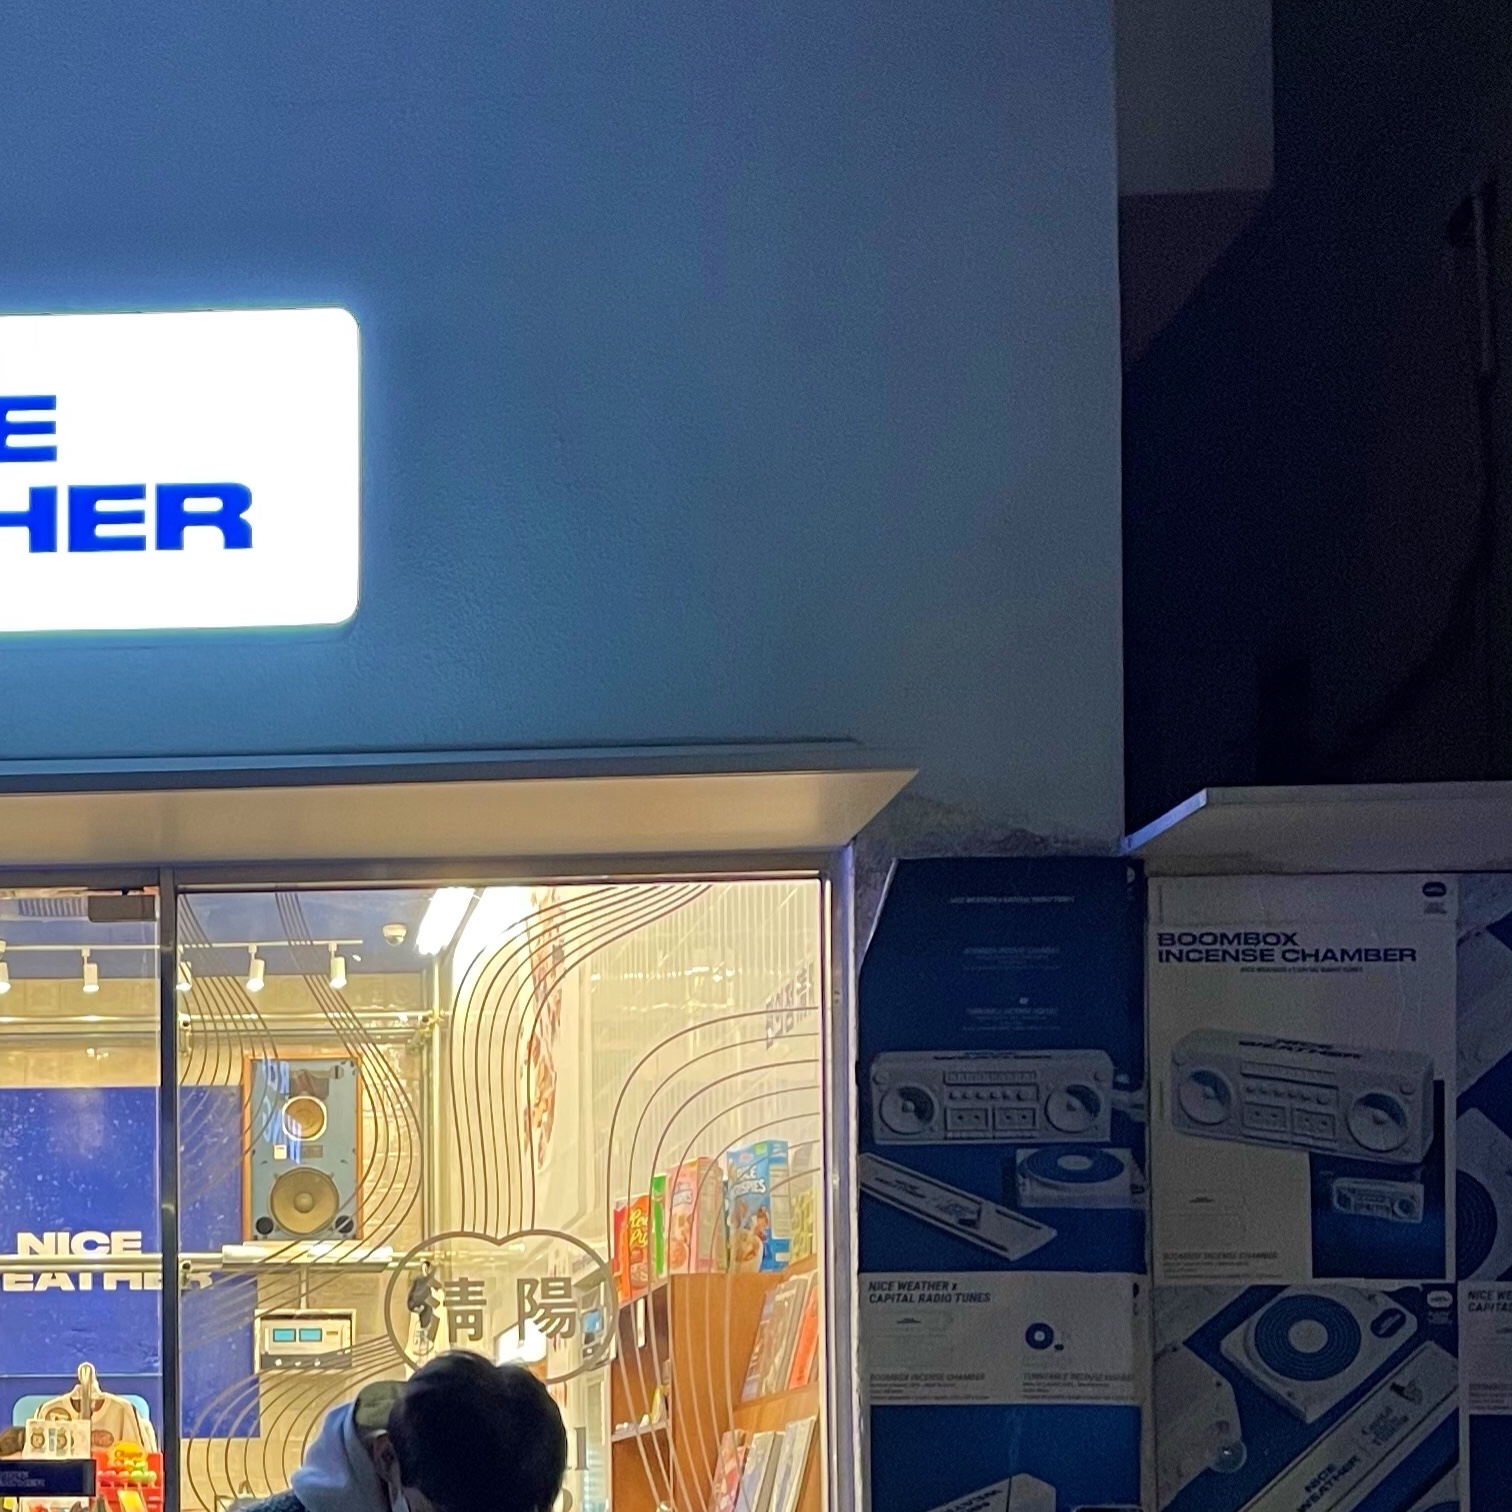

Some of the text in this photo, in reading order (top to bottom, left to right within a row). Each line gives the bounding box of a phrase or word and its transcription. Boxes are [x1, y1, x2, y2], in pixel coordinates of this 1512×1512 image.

[1157, 931, 1299, 947] BOOMBOX
[1158, 947, 1417, 963] INCENSE CHAMBER
[16, 1230, 142, 1255] NICE
[868, 1281, 895, 1292] NICE
[897, 1281, 950, 1292] WEATHER
[869, 1292, 991, 1304] CAPITAL RADIO TUNES
